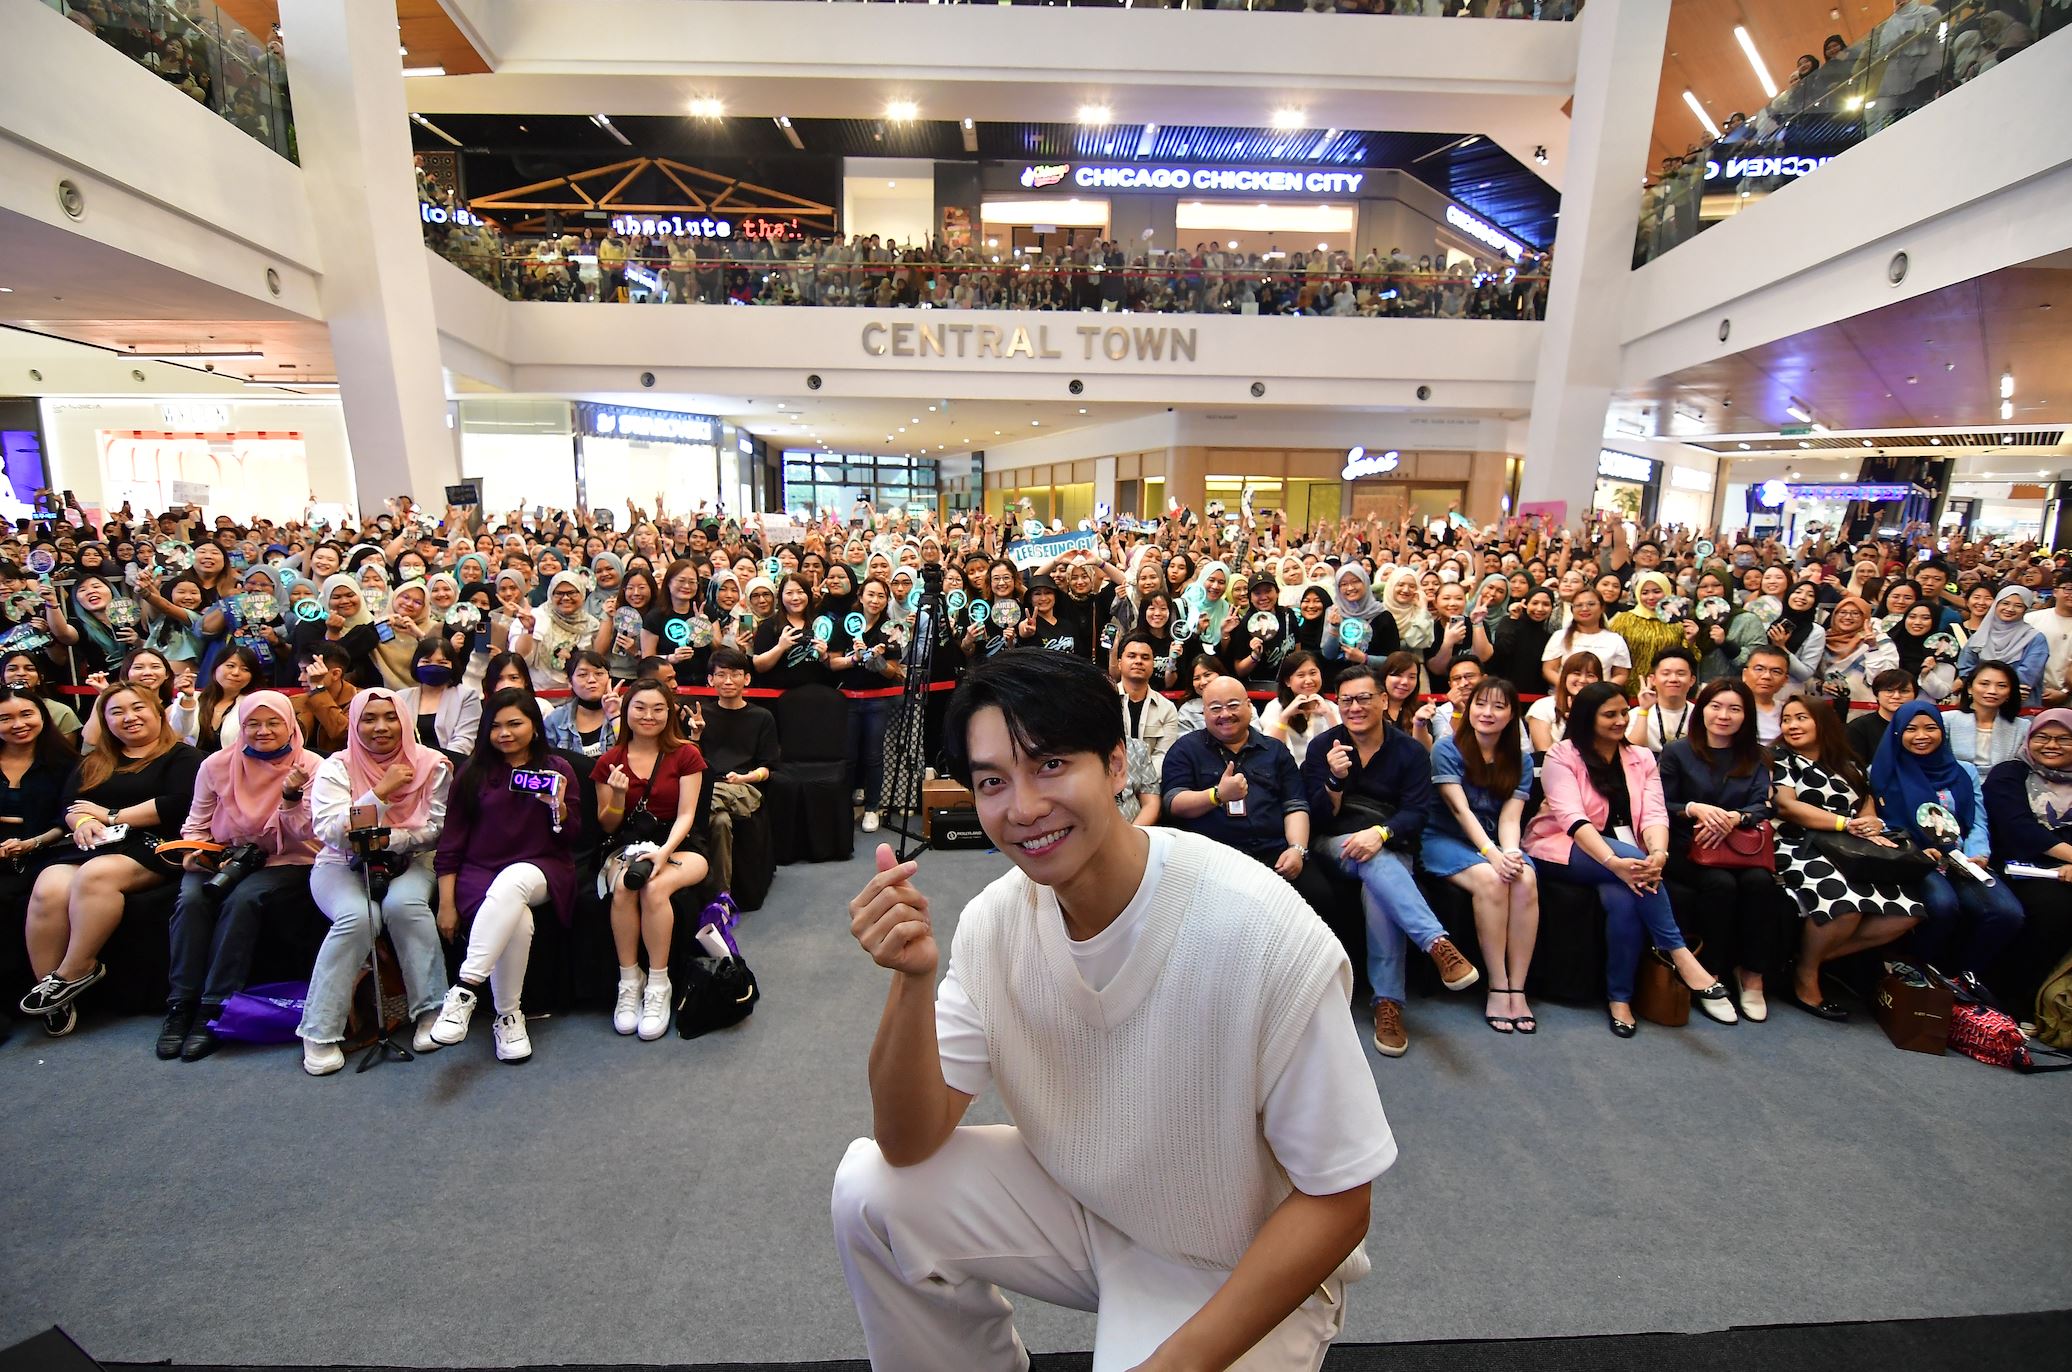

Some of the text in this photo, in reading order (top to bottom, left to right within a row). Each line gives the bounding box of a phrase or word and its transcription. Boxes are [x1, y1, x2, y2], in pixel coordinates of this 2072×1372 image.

[1075, 167, 1190, 188] CHICAGO
[1192, 169, 1303, 191] CHICKEN
[1305, 172, 1363, 193] CITY
[862, 321, 1197, 362] CENTRAL TOWN
[1015, 544, 1034, 562] LEE
[513, 773, 556, 792] 이승기
